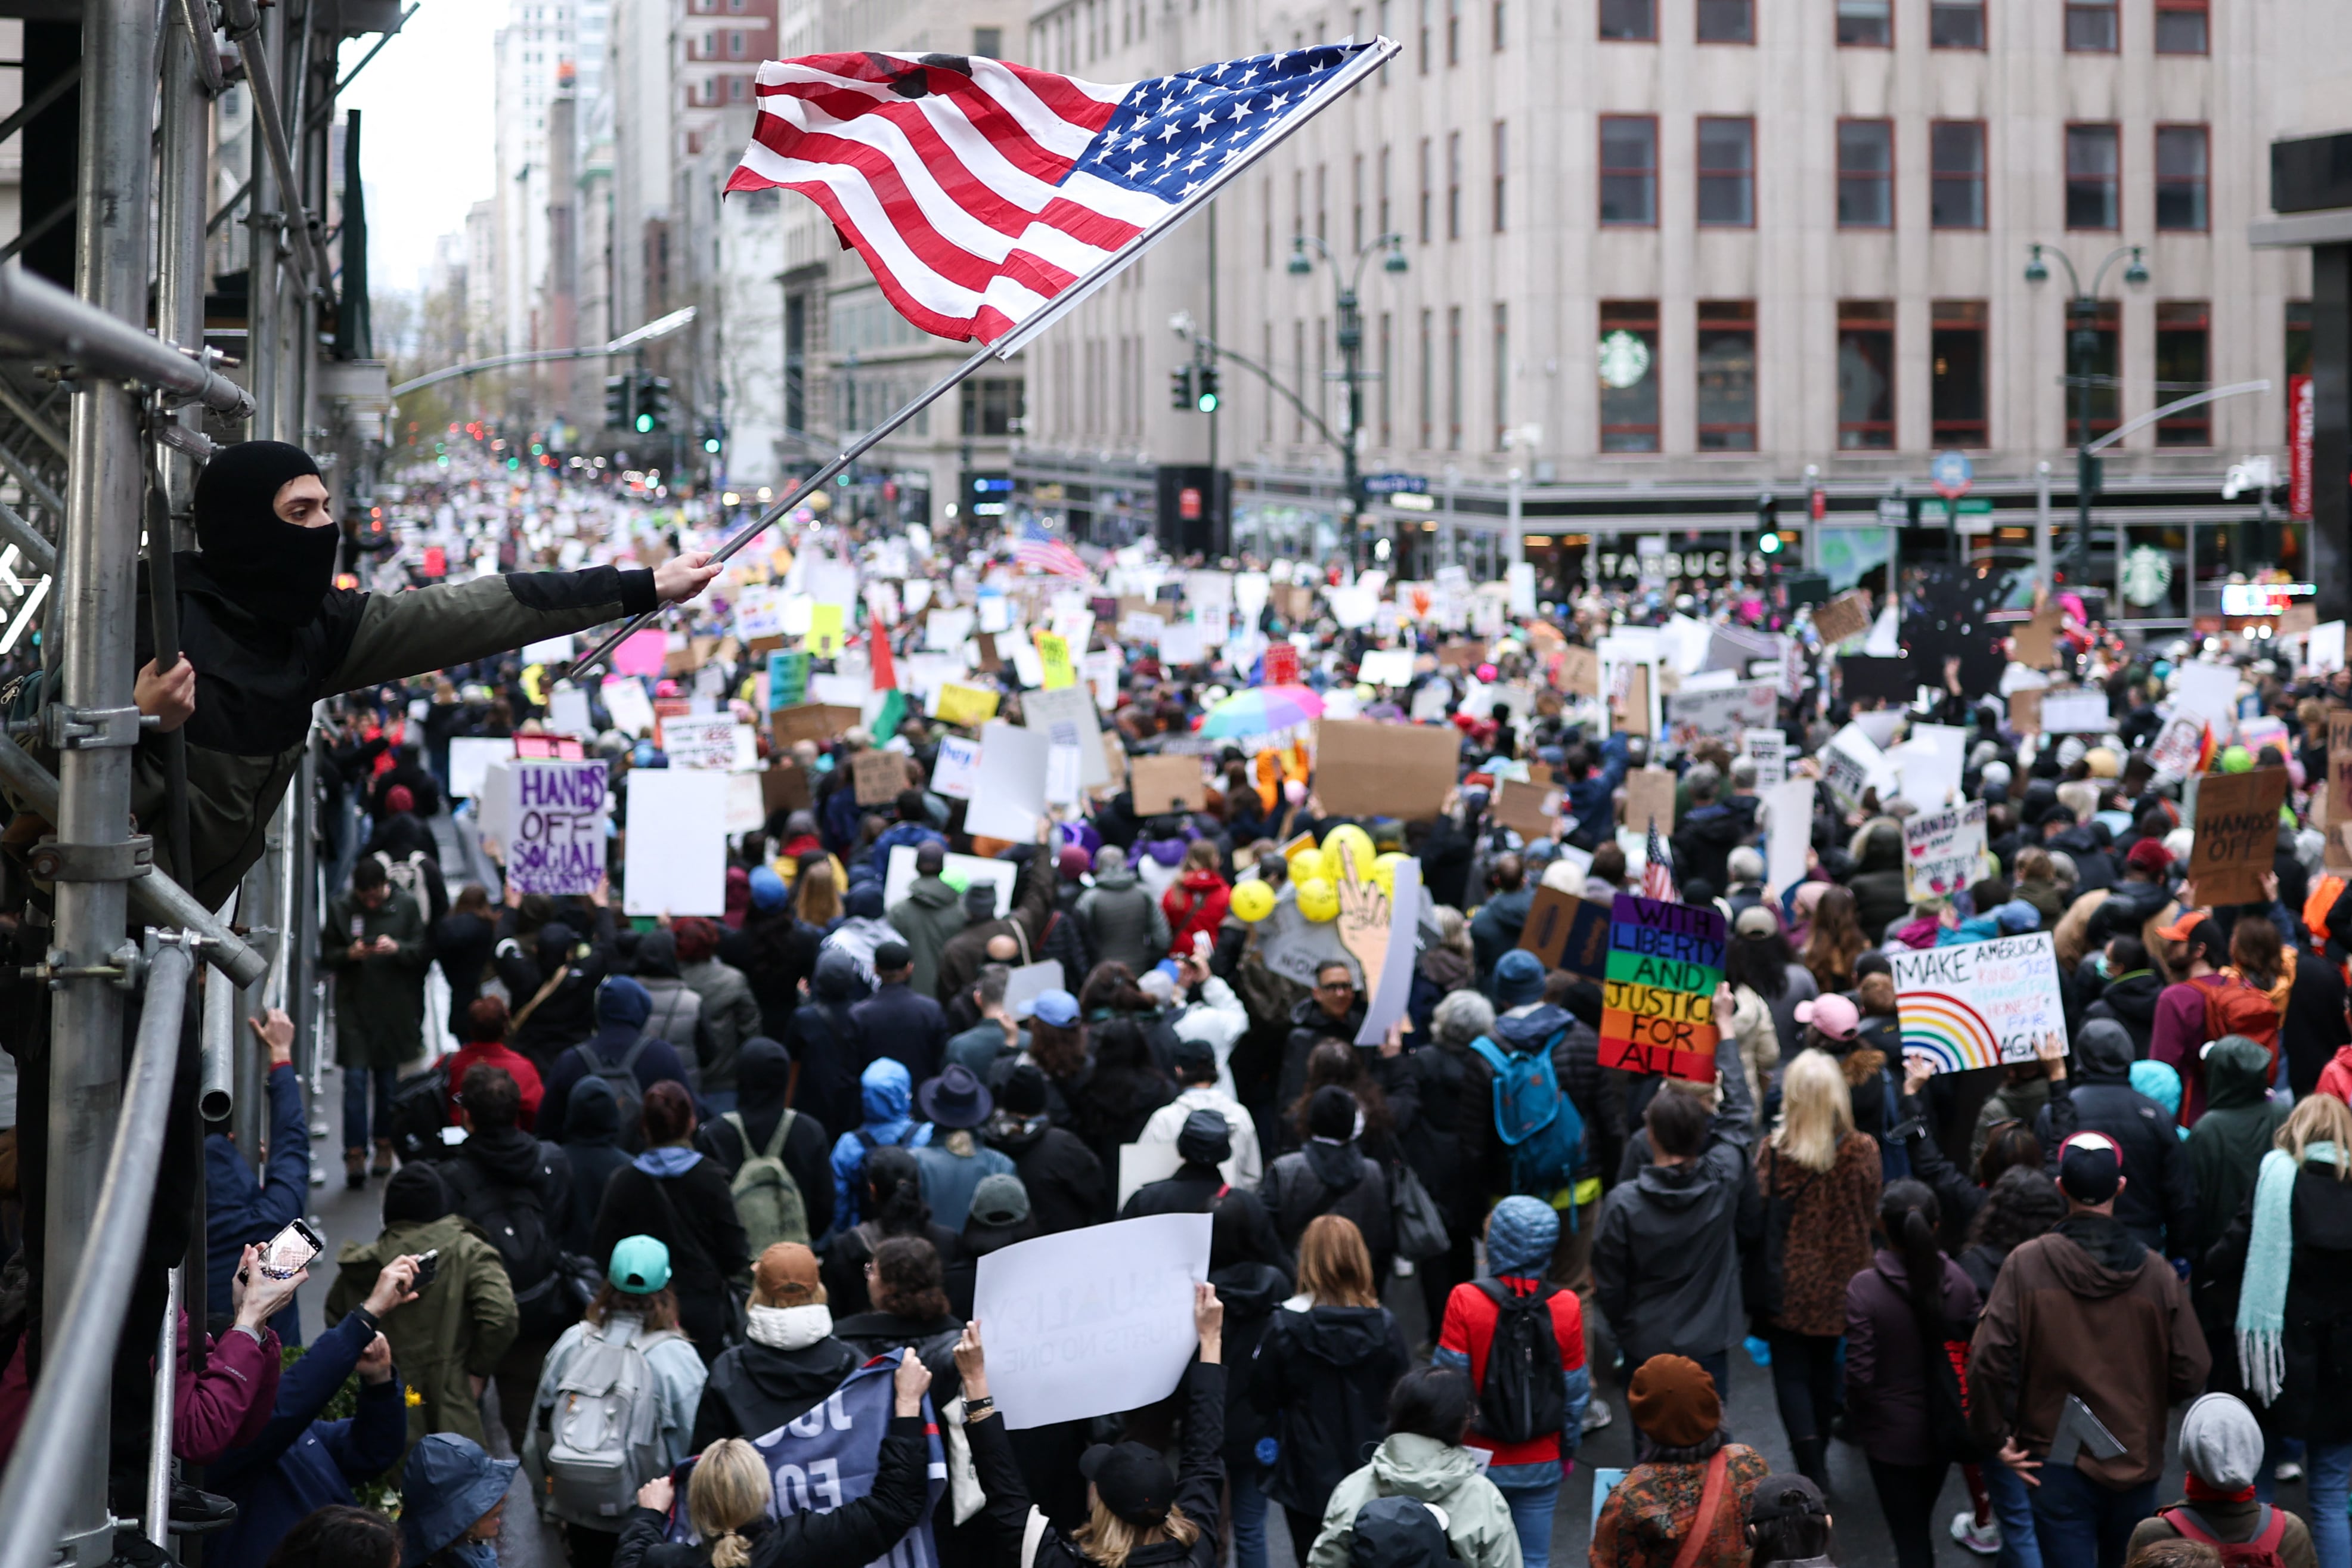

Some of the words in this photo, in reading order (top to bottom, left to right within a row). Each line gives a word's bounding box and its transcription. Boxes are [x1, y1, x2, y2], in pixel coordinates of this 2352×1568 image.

[1581, 550, 1767, 579] STARBUCKS
[521, 766, 605, 812] HANDS
[522, 810, 595, 845] OFF
[2204, 809, 2276, 839] HANDS
[512, 841, 602, 874] SOCIAL
[2208, 835, 2261, 863] OFF
[1632, 897, 1710, 936] WITH
[1613, 924, 1724, 966] LIBERTY
[1633, 957, 1705, 991] AND
[1897, 948, 1970, 988] MAKE
[1975, 938, 2047, 962] AMERICA
[1631, 1014, 1694, 1051] FOR
[1616, 1043, 1687, 1079] ALL
